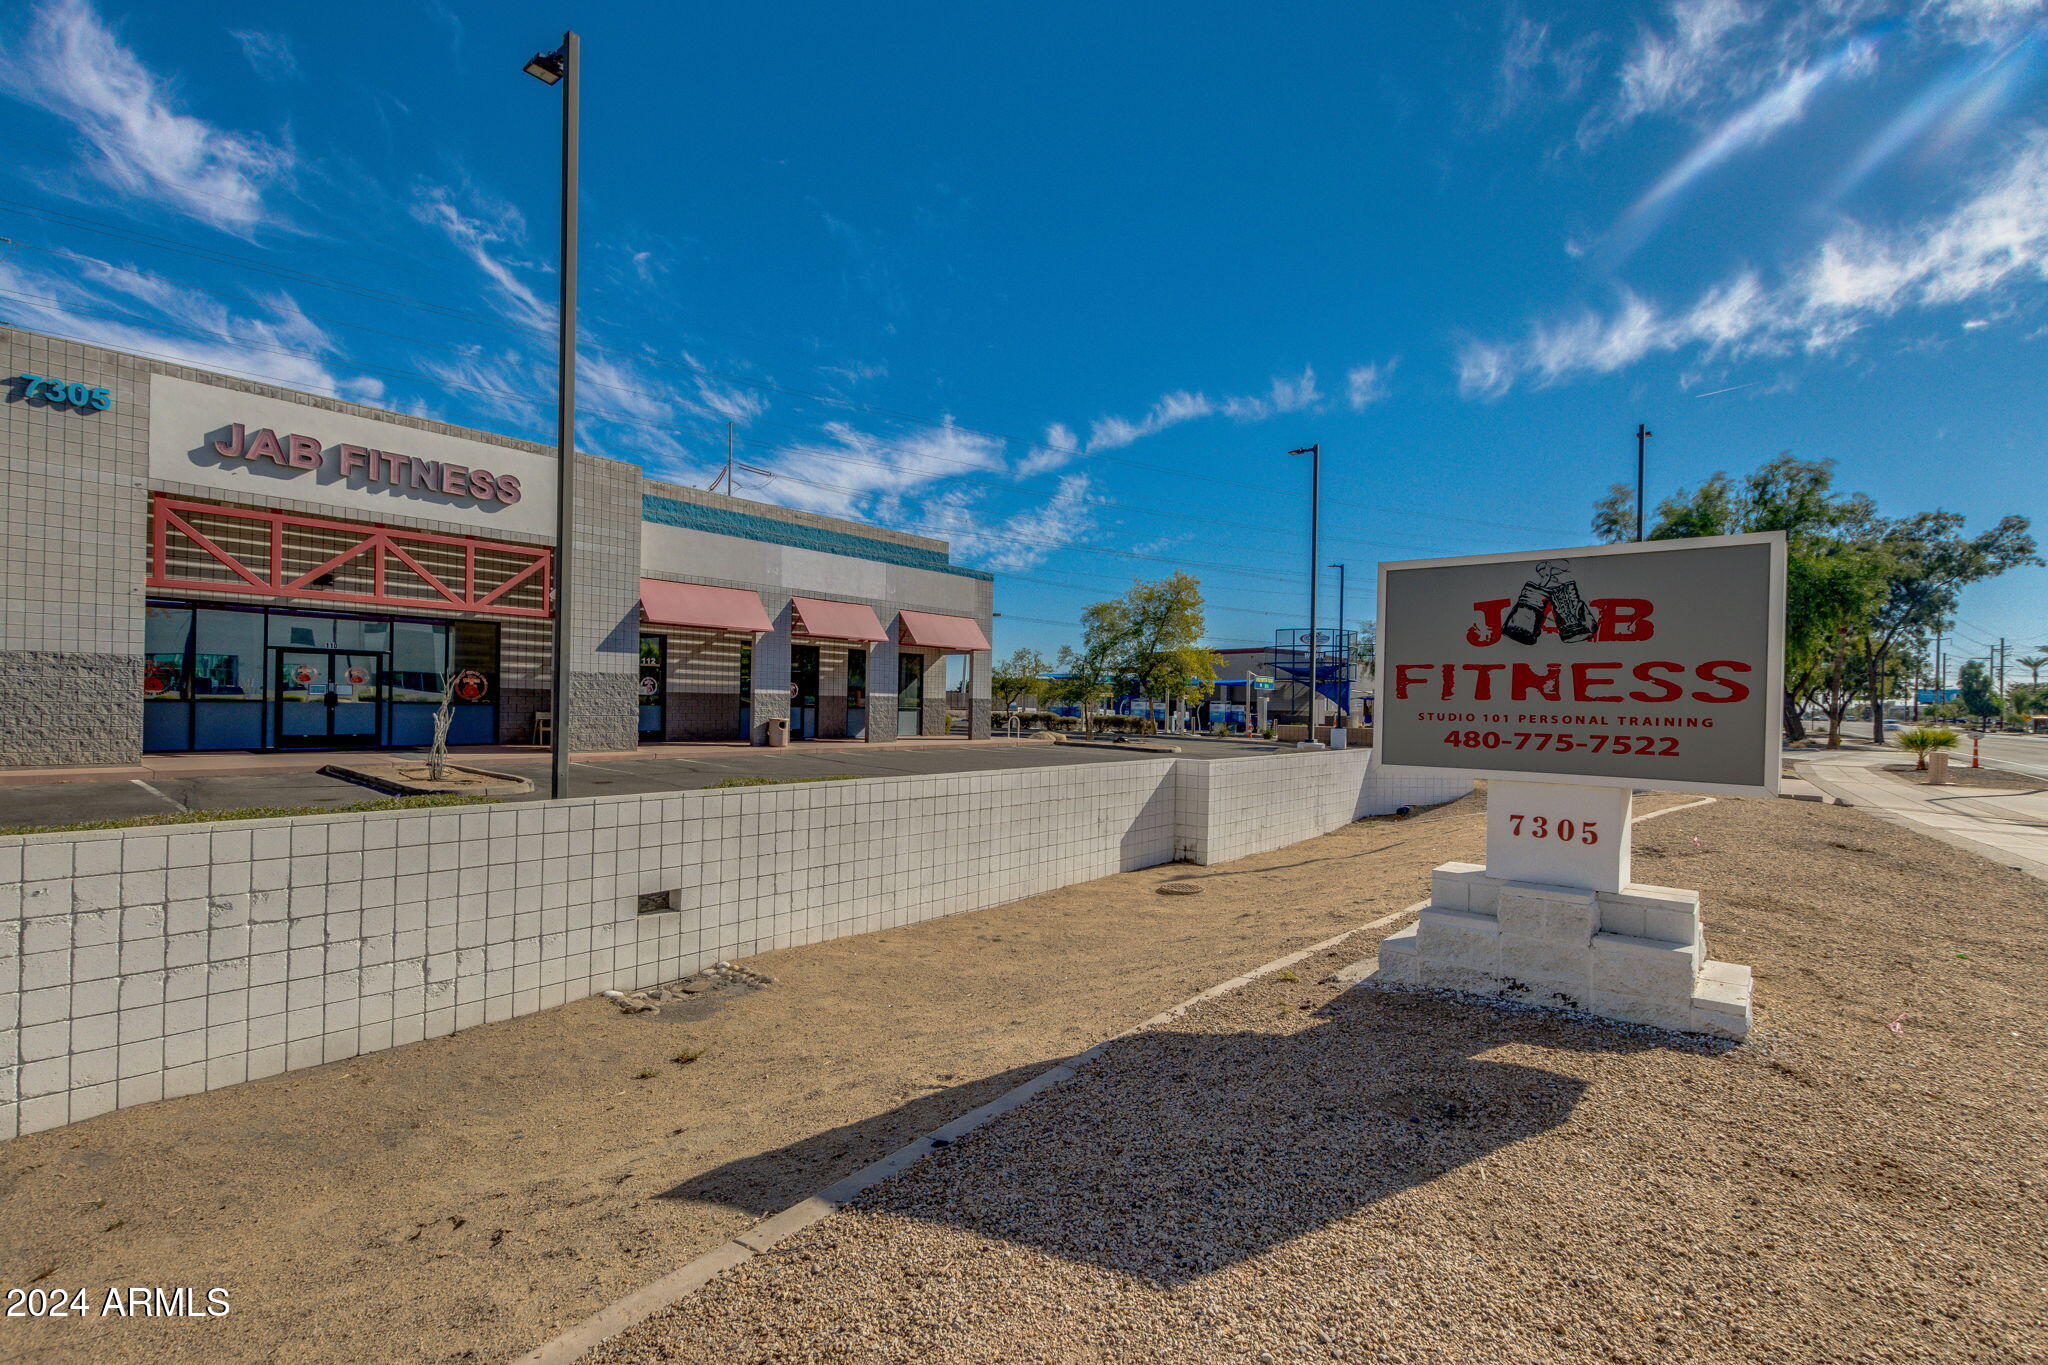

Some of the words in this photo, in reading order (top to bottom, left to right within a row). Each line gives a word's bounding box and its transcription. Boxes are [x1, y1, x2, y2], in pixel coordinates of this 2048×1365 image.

[20, 373, 112, 411] 7305
[215, 422, 323, 470] JAB
[340, 442, 522, 505] FITNESS
[641, 657, 656, 665] 112
[1396, 660, 1752, 704] FITNESS
[1418, 712, 1475, 723] STUDIO
[1483, 714, 1509, 724] 101
[1518, 714, 1609, 726] PERSONAL
[1617, 716, 1714, 728] TRAINING
[1444, 730, 1680, 757] 480-775-7522
[1509, 814, 1599, 845] 7305
